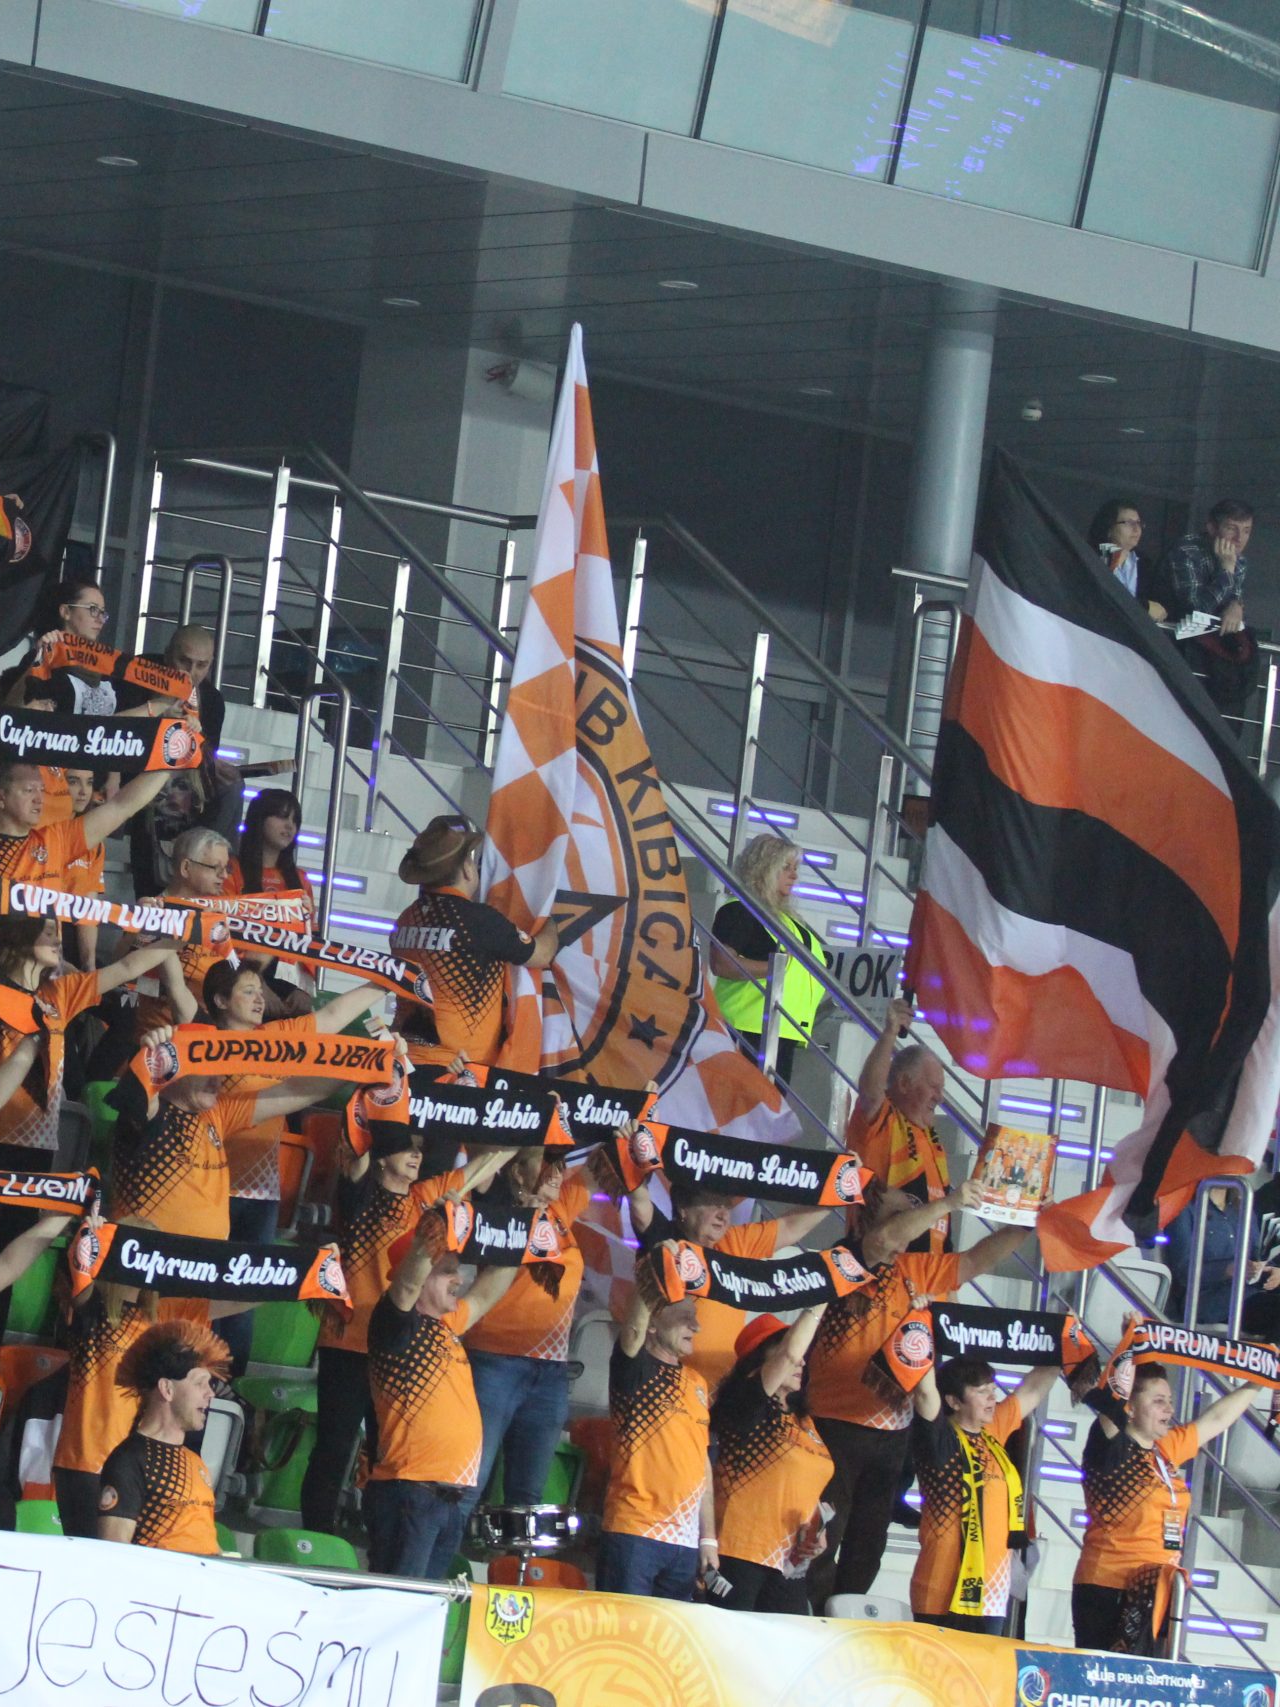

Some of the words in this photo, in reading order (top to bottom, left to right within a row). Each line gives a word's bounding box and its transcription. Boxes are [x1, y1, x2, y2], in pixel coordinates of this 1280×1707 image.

[63, 633, 115, 656] CUPRUM
[134, 668, 170, 692] LUBIN
[0, 714, 80, 756] Cuprum
[84, 725, 145, 757] Lubin
[10, 883, 112, 925] CUPRUM
[118, 903, 190, 938] LUBIN
[225, 917, 313, 954] PRUM
[319, 940, 407, 982] LUBIN
[394, 926, 456, 952] ARTEK
[188, 1040, 308, 1064] CUPRUM
[314, 1042, 387, 1072] LUBIN
[408, 1094, 479, 1129] uprum
[482, 1098, 541, 1130] Lubin
[574, 1093, 630, 1126] Lubin
[674, 1138, 755, 1181] Cuprum
[758, 1153, 819, 1189] Lubin
[2, 1173, 91, 1203] LUBIN
[121, 1239, 219, 1284] Cuprum
[223, 1253, 298, 1286] Lubin
[711, 1260, 776, 1303] Cuprum
[773, 1267, 827, 1296] Lubin
[940, 1314, 1003, 1353] Cuprum
[1007, 1320, 1056, 1353] Lubin
[1133, 1324, 1220, 1361] CUPRUM
[1223, 1340, 1279, 1379] LUBIN
[1087, 1669, 1116, 1683] KLUB
[1117, 1673, 1145, 1685] PIŁKI
